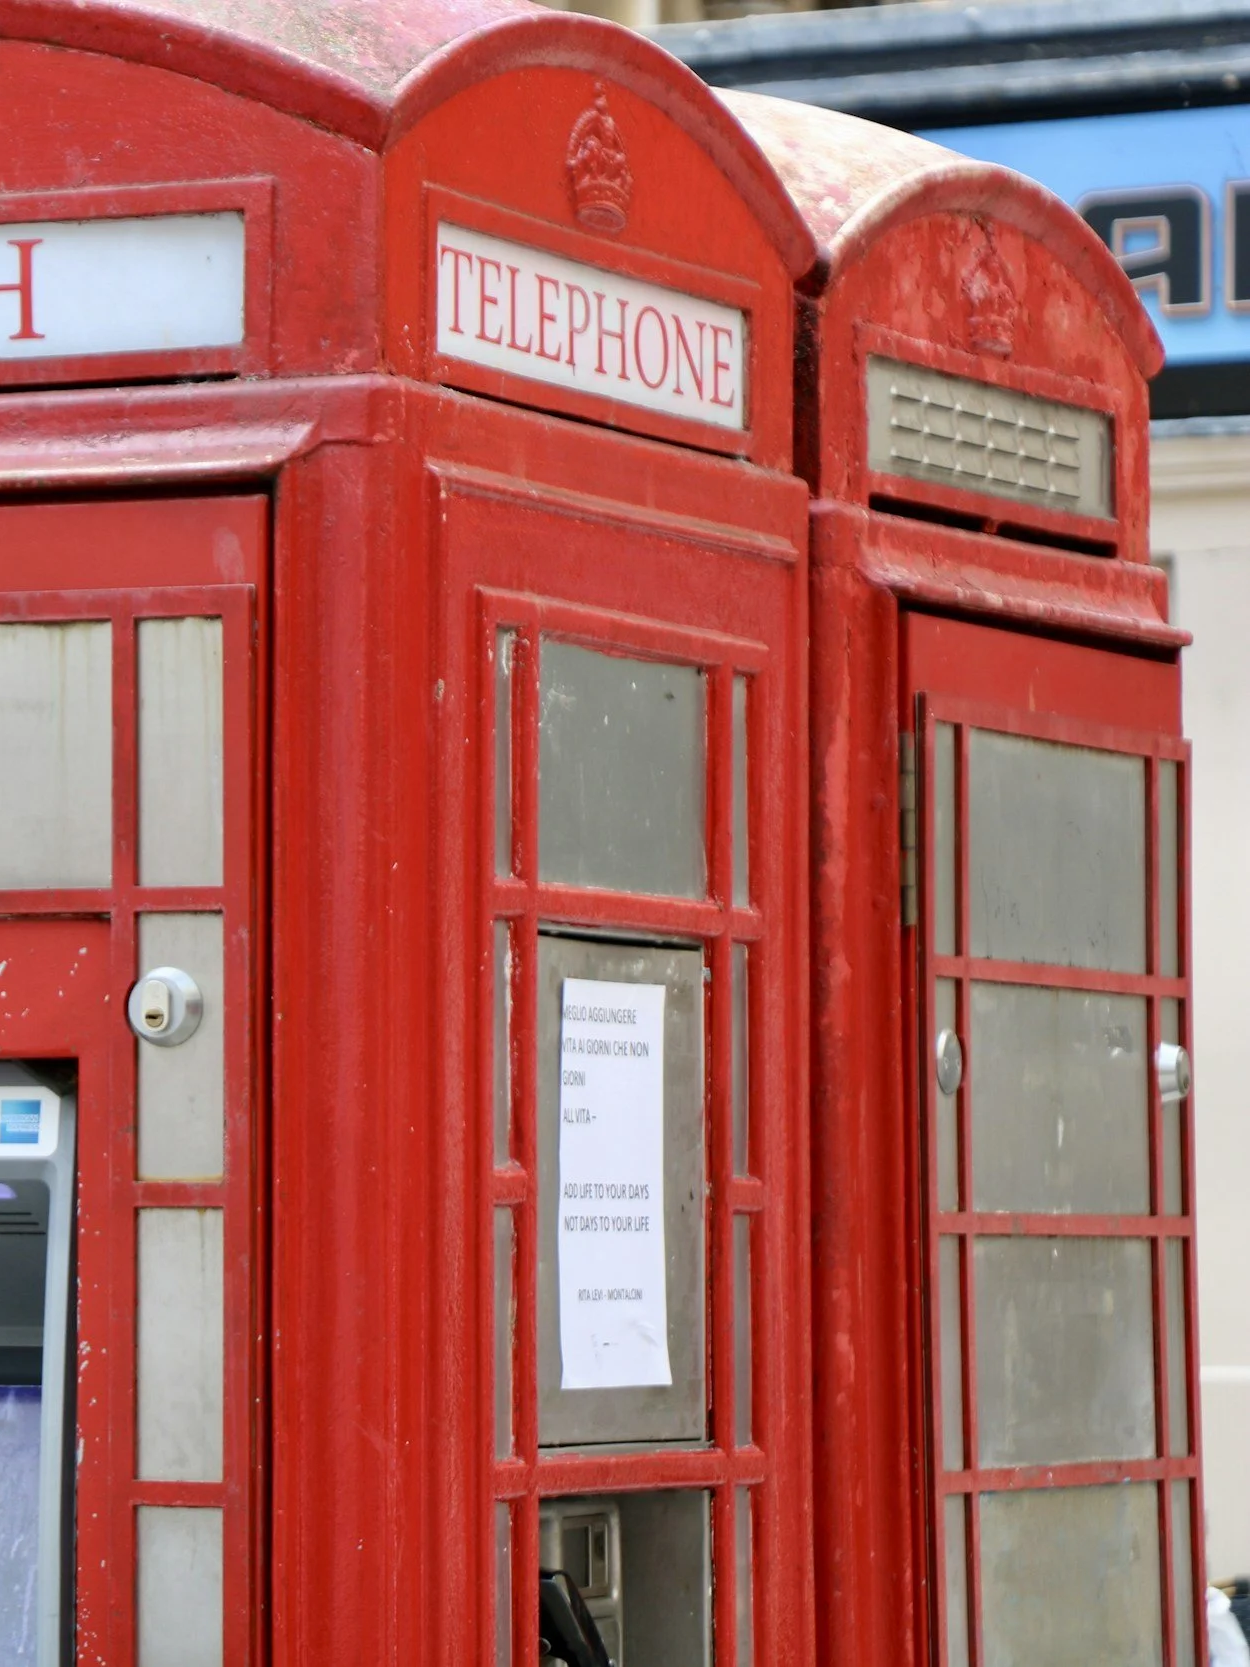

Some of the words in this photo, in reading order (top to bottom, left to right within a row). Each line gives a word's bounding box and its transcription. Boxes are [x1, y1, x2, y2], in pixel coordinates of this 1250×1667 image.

[441, 244, 735, 408] TELEPHONE
[588, 1006, 637, 1025] AGGIUNGERE
[563, 1037, 577, 1053] VITA
[578, 1038, 585, 1054] AI
[586, 1038, 612, 1055] GIORNI
[613, 1040, 628, 1056] CHE
[629, 1041, 649, 1058] NON
[563, 1070, 586, 1086] GIORNI
[563, 1107, 574, 1124] ALL
[575, 1108, 591, 1125] VITA
[564, 1183, 579, 1199] ADD
[579, 1183, 593, 1199] LIFE
[594, 1184, 604, 1200] TO
[605, 1183, 627, 1200] YOUR
[628, 1184, 650, 1200] DAYS
[565, 1216, 578, 1232] NOT
[580, 1216, 598, 1232] DAYS
[600, 1216, 610, 1232] TO
[611, 1216, 633, 1232] YOUR
[634, 1216, 649, 1231] LIFE
